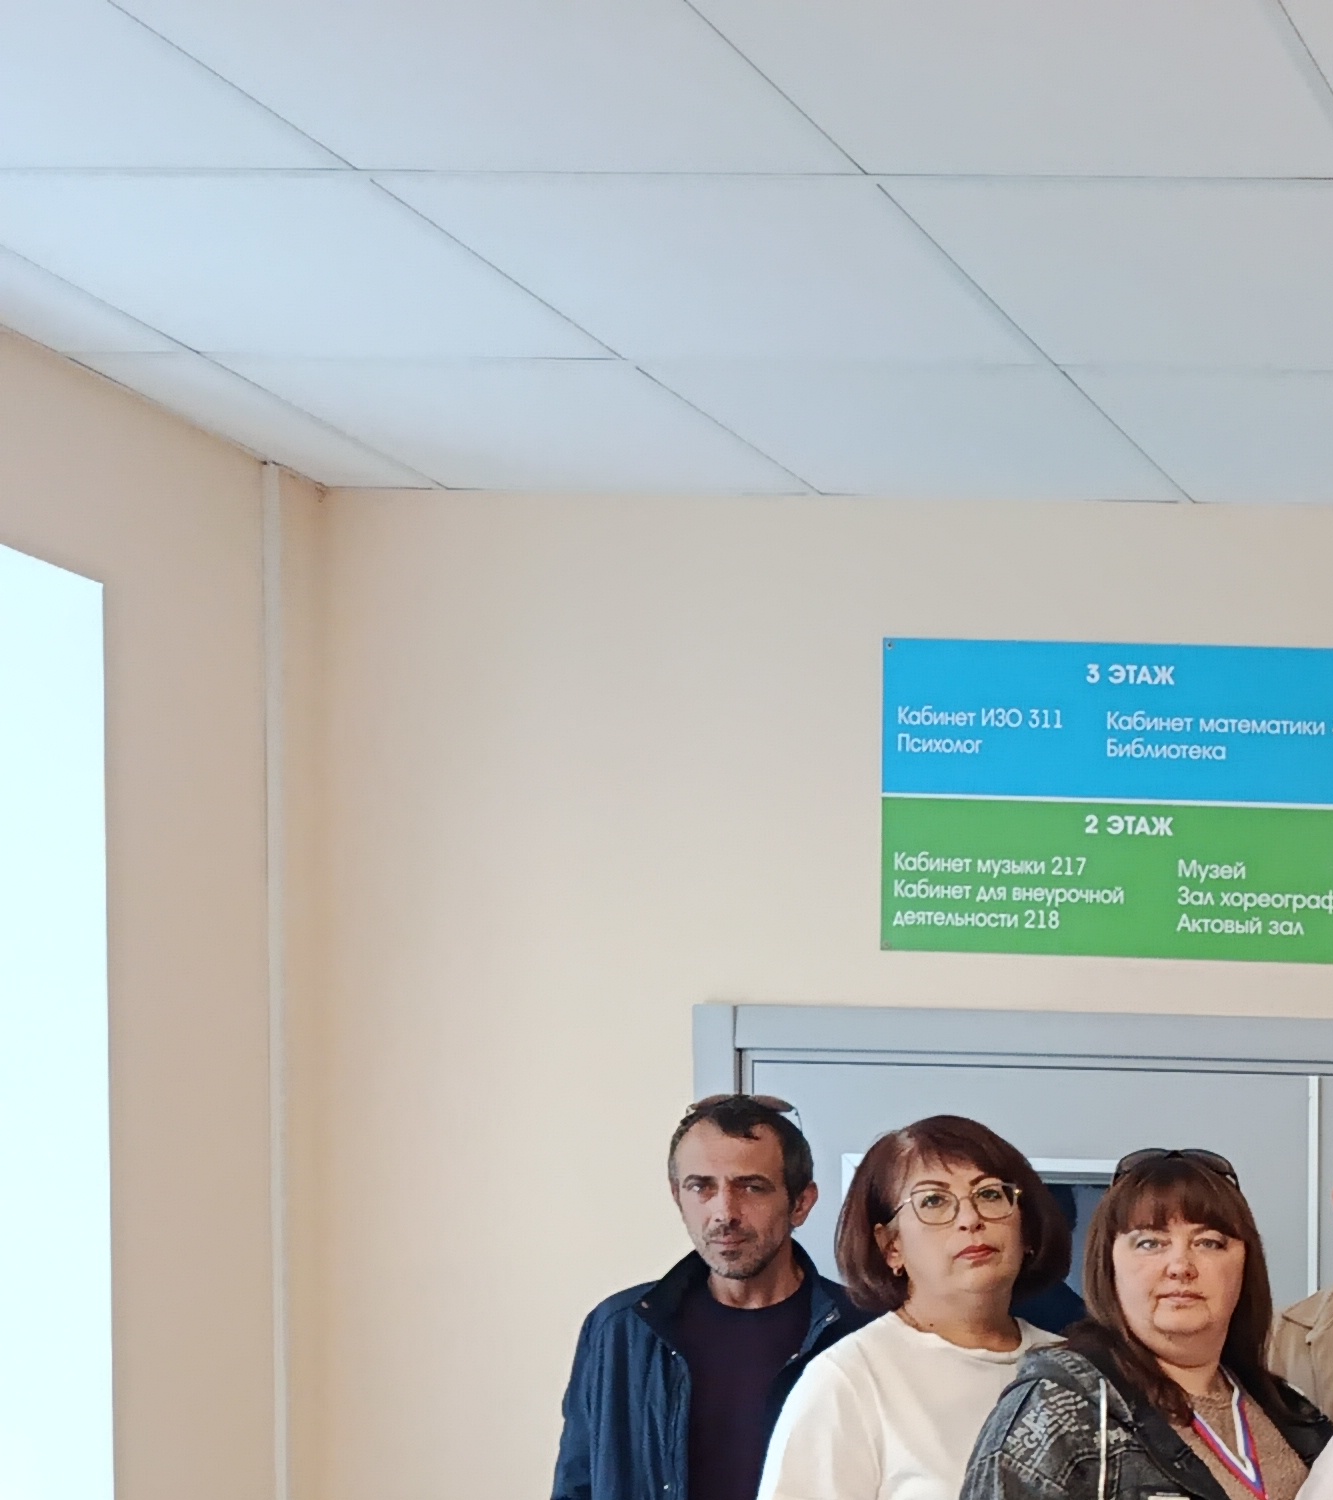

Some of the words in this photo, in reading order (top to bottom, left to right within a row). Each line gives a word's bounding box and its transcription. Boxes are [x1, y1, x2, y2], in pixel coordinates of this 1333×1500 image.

[1087, 664, 1100, 683] 3
[1109, 664, 1174, 684] ЭТАЖ
[898, 706, 976, 726] Кабинет
[982, 708, 1022, 727] ИЗО
[1029, 709, 1062, 728] 311
[1107, 711, 1193, 731] Кабинет
[1200, 719, 1325, 735] математики
[898, 733, 982, 753] Психолог
[1107, 738, 1226, 760] Библиотека
[1085, 815, 1098, 833] 2
[1107, 816, 1173, 836] ЭТАЖ
[895, 851, 972, 872] Кабинет
[977, 859, 1045, 878] музыки
[1052, 856, 1086, 875] 217
[1178, 859, 1245, 883] Музей
[894, 879, 971, 899] Кабинет
[976, 886, 1006, 902] для
[1012, 887, 1124, 907] внеурочной
[1178, 886, 1214, 905] Зал
[893, 911, 1018, 927] деятельности
[1025, 910, 1059, 929] 218
[1177, 911, 1262, 934] Актовый
[1268, 921, 1304, 935] зал
